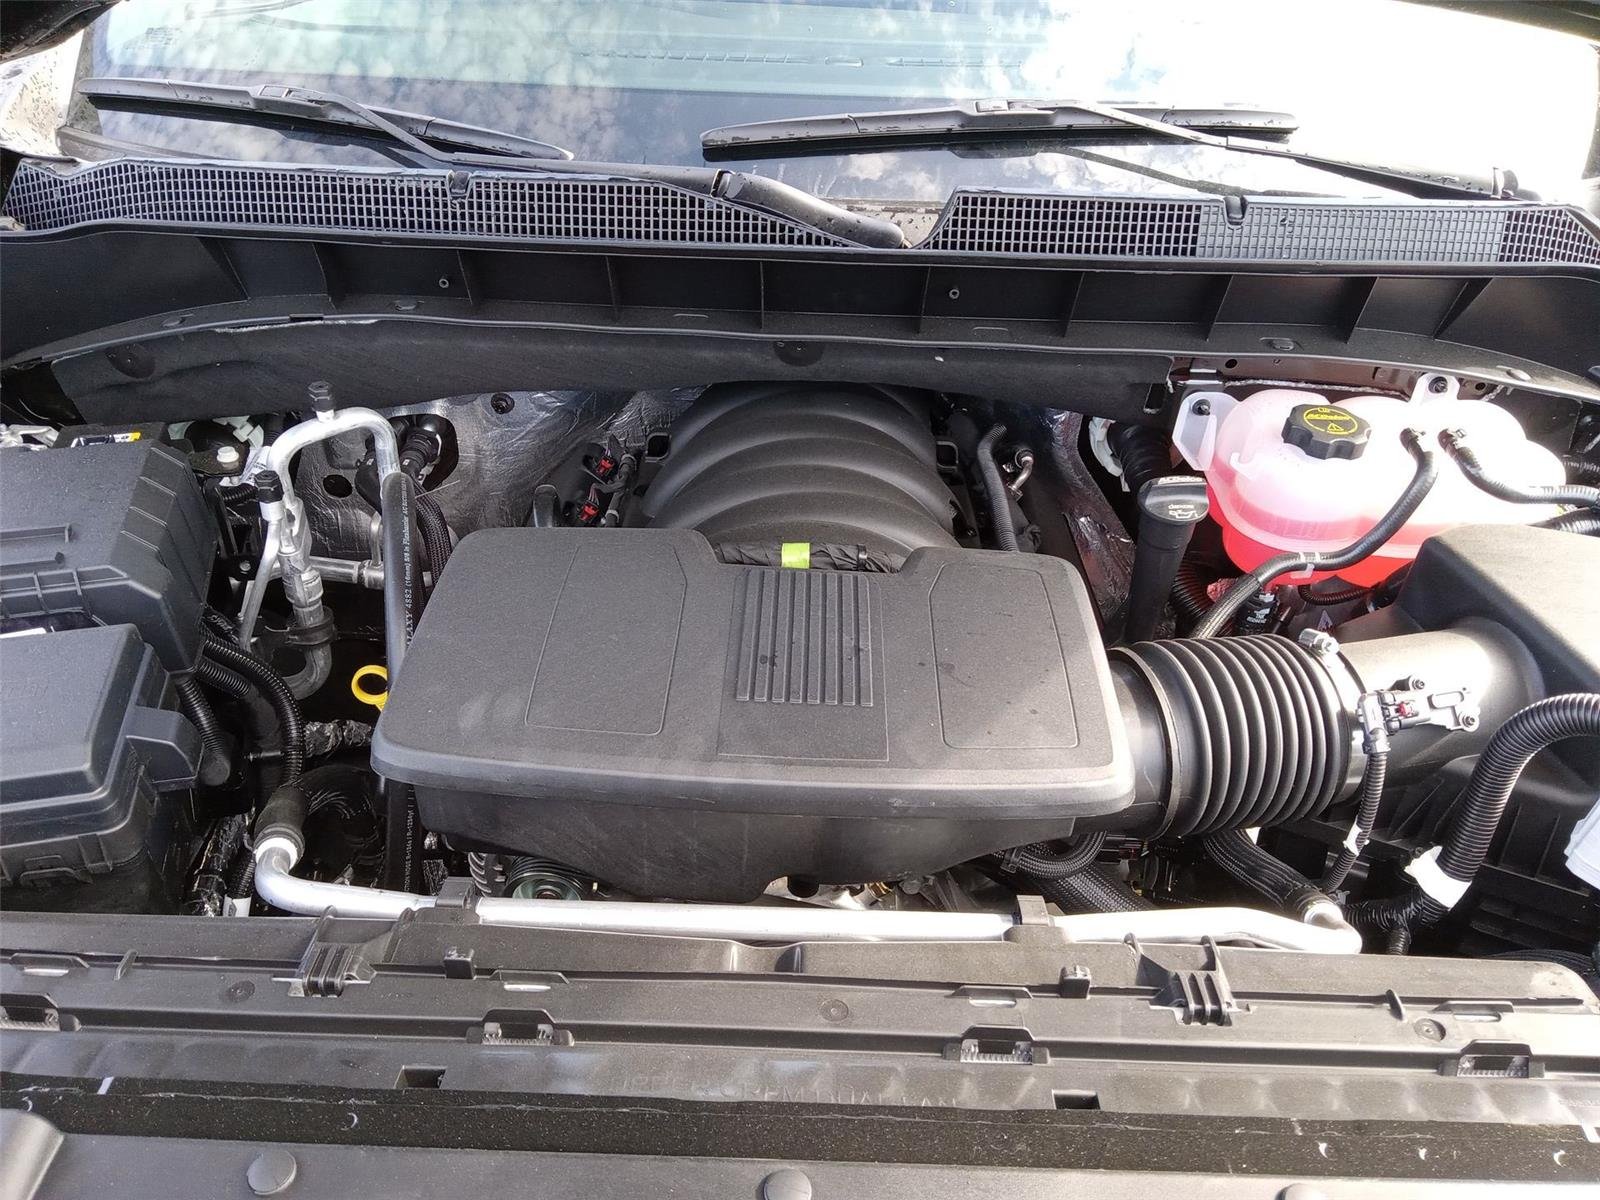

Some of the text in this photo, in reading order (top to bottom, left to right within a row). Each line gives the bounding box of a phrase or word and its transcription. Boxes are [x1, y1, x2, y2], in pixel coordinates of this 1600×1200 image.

[1158, 475, 1203, 485] ACDelco
[404, 563, 412, 587] (16mm)
[404, 589, 413, 609] 4882
